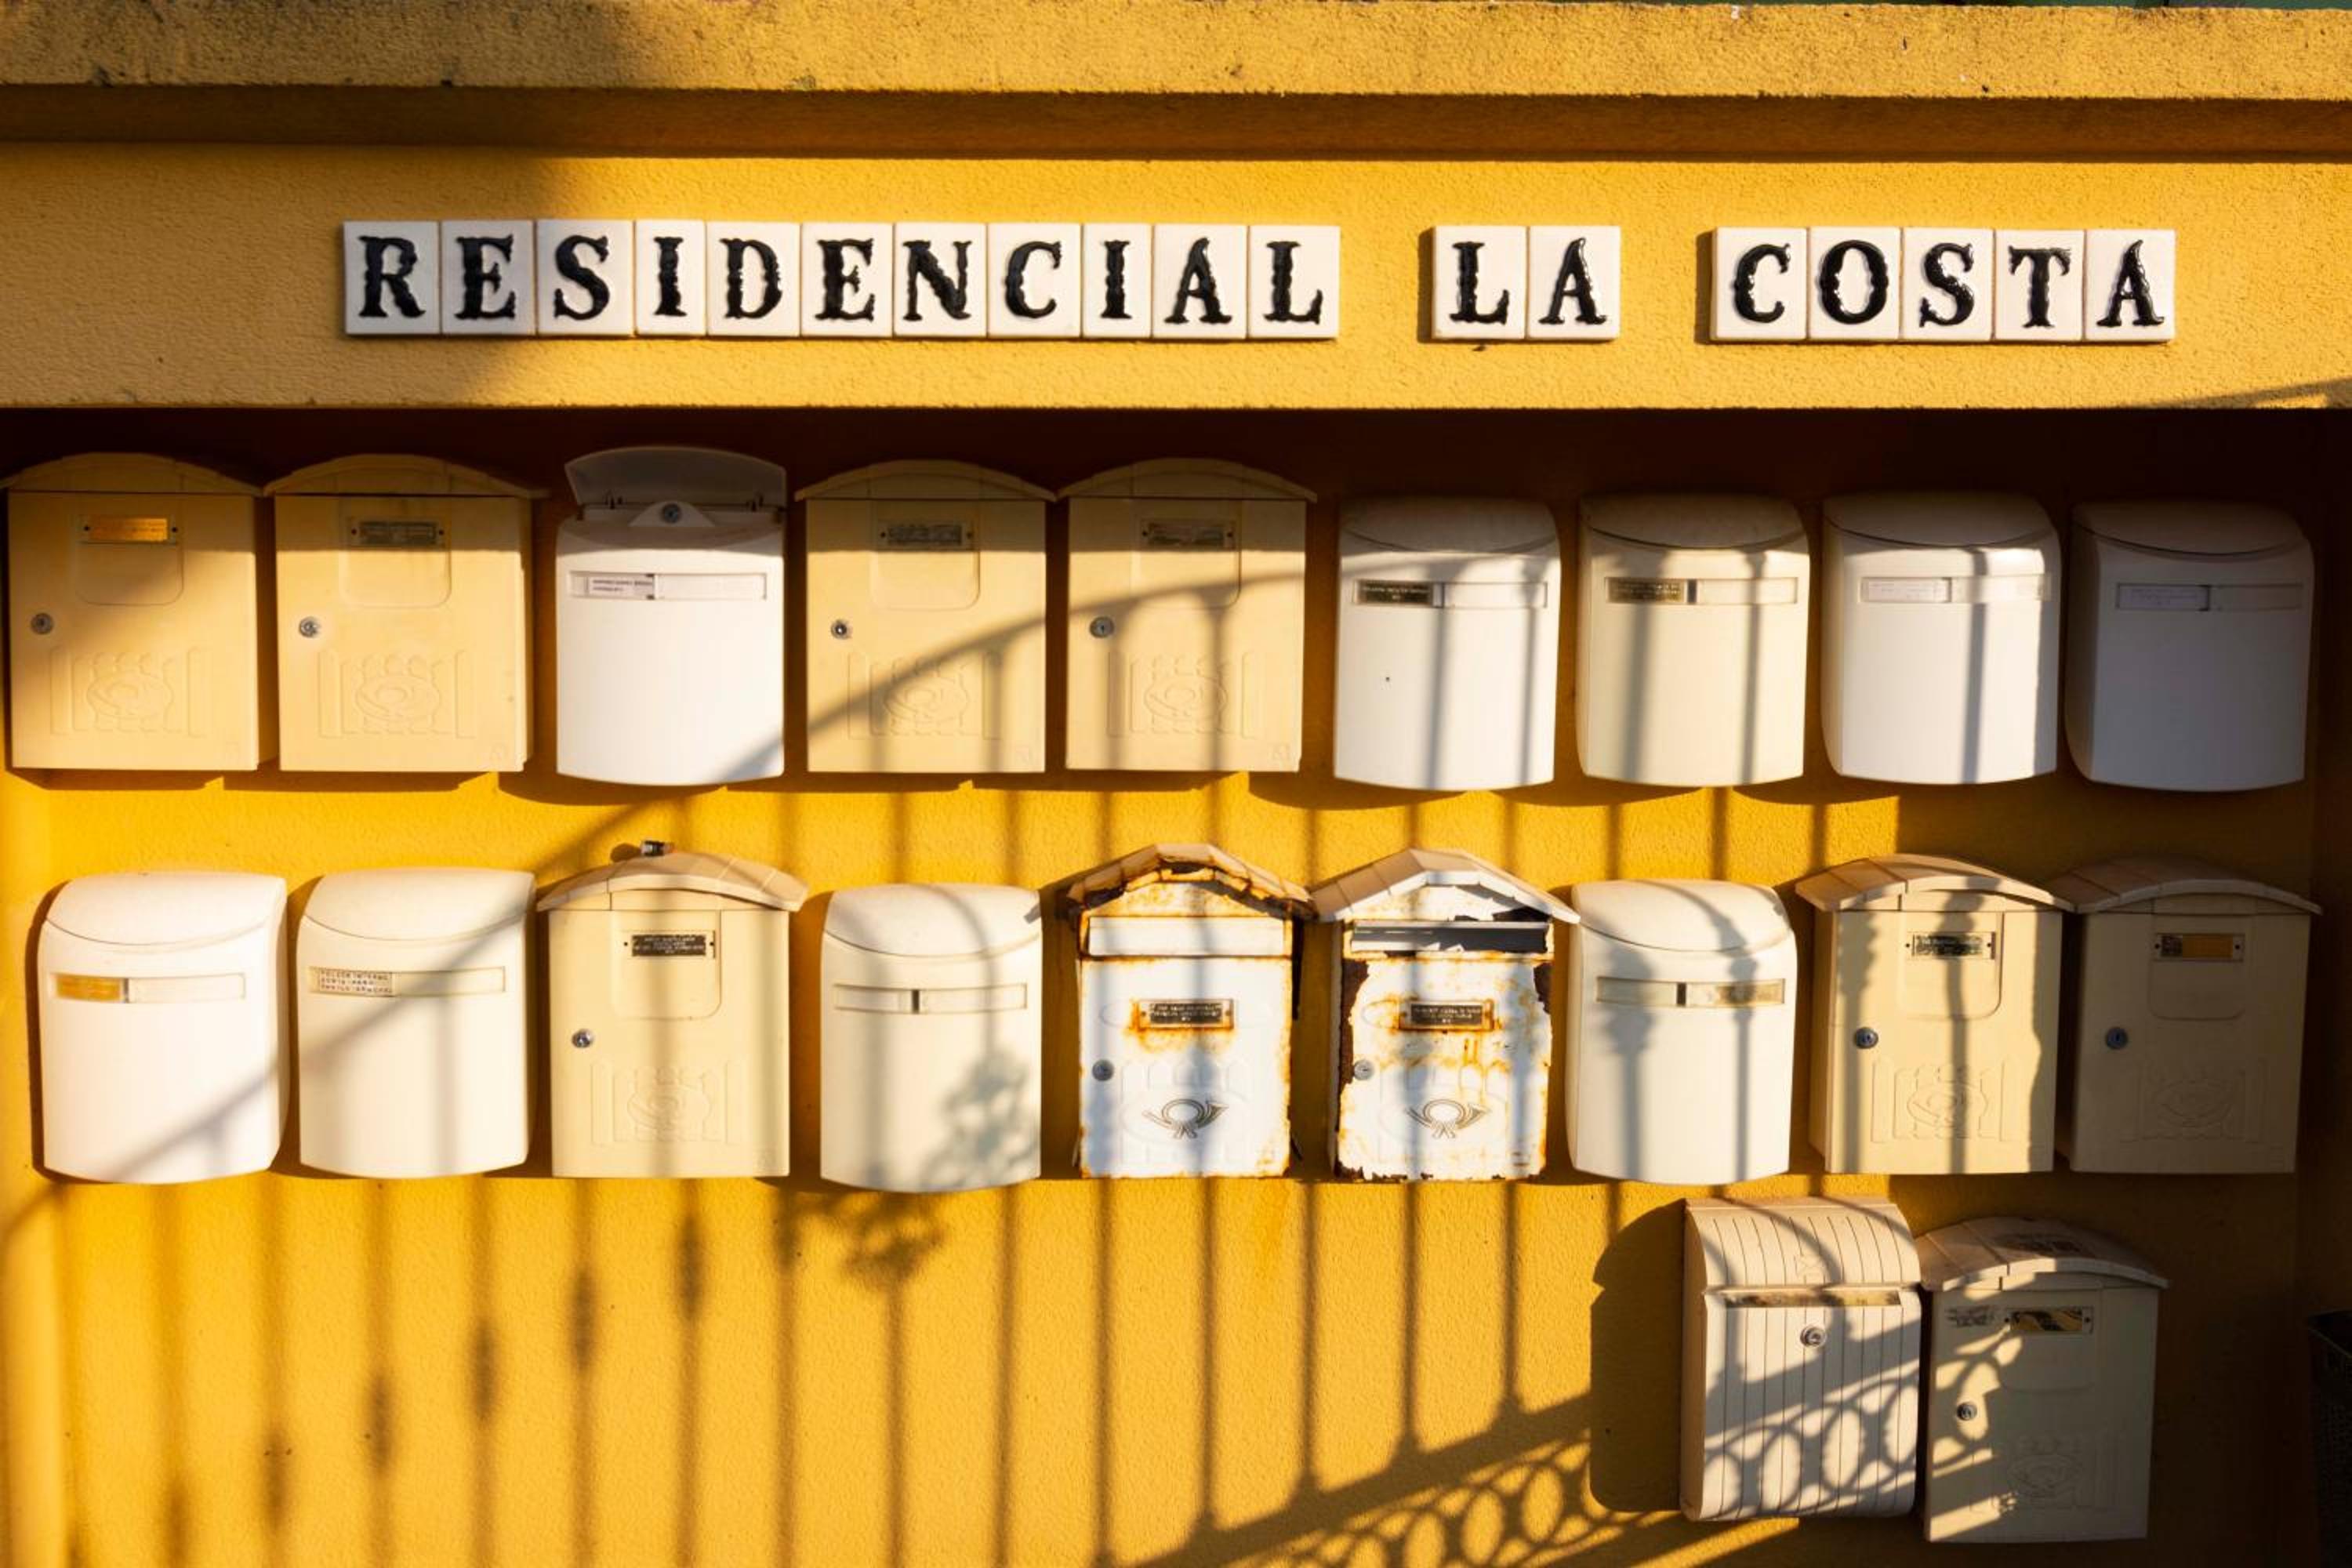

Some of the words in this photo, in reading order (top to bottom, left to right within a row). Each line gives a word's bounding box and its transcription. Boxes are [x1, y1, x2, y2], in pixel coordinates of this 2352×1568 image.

[358, 234, 1323, 324] RESIDENCIAL
[1448, 237, 1608, 325] LA
[1733, 238, 2165, 328] COSTA
